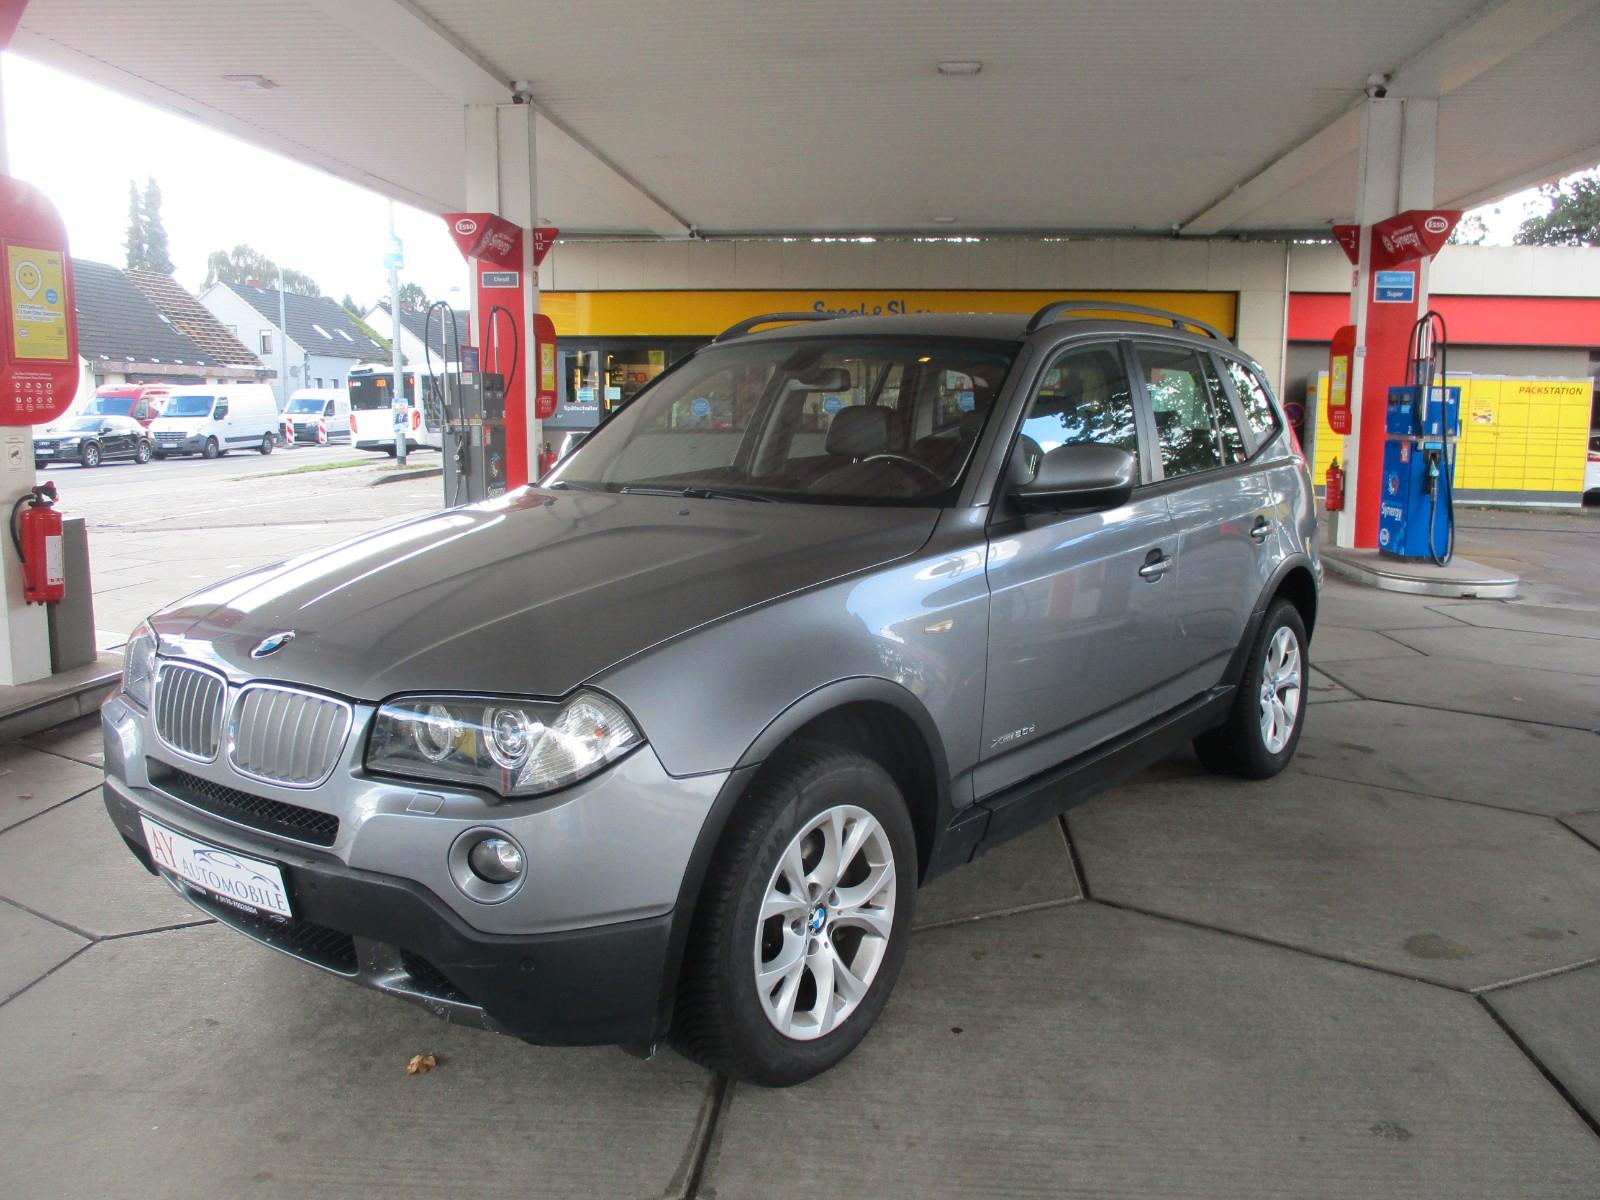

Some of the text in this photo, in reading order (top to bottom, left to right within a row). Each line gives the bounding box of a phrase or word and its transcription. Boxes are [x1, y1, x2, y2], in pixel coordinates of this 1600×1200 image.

[458, 222, 474, 230] Esso
[1428, 221, 1445, 229] Esso
[534, 232, 543, 240] 11
[534, 242, 544, 250] 12
[1349, 241, 1355, 249] 2
[1518, 386, 1584, 395] PACKSTATION
[152, 828, 177, 868] AY
[181, 856, 287, 912] AUTOMOBILE
